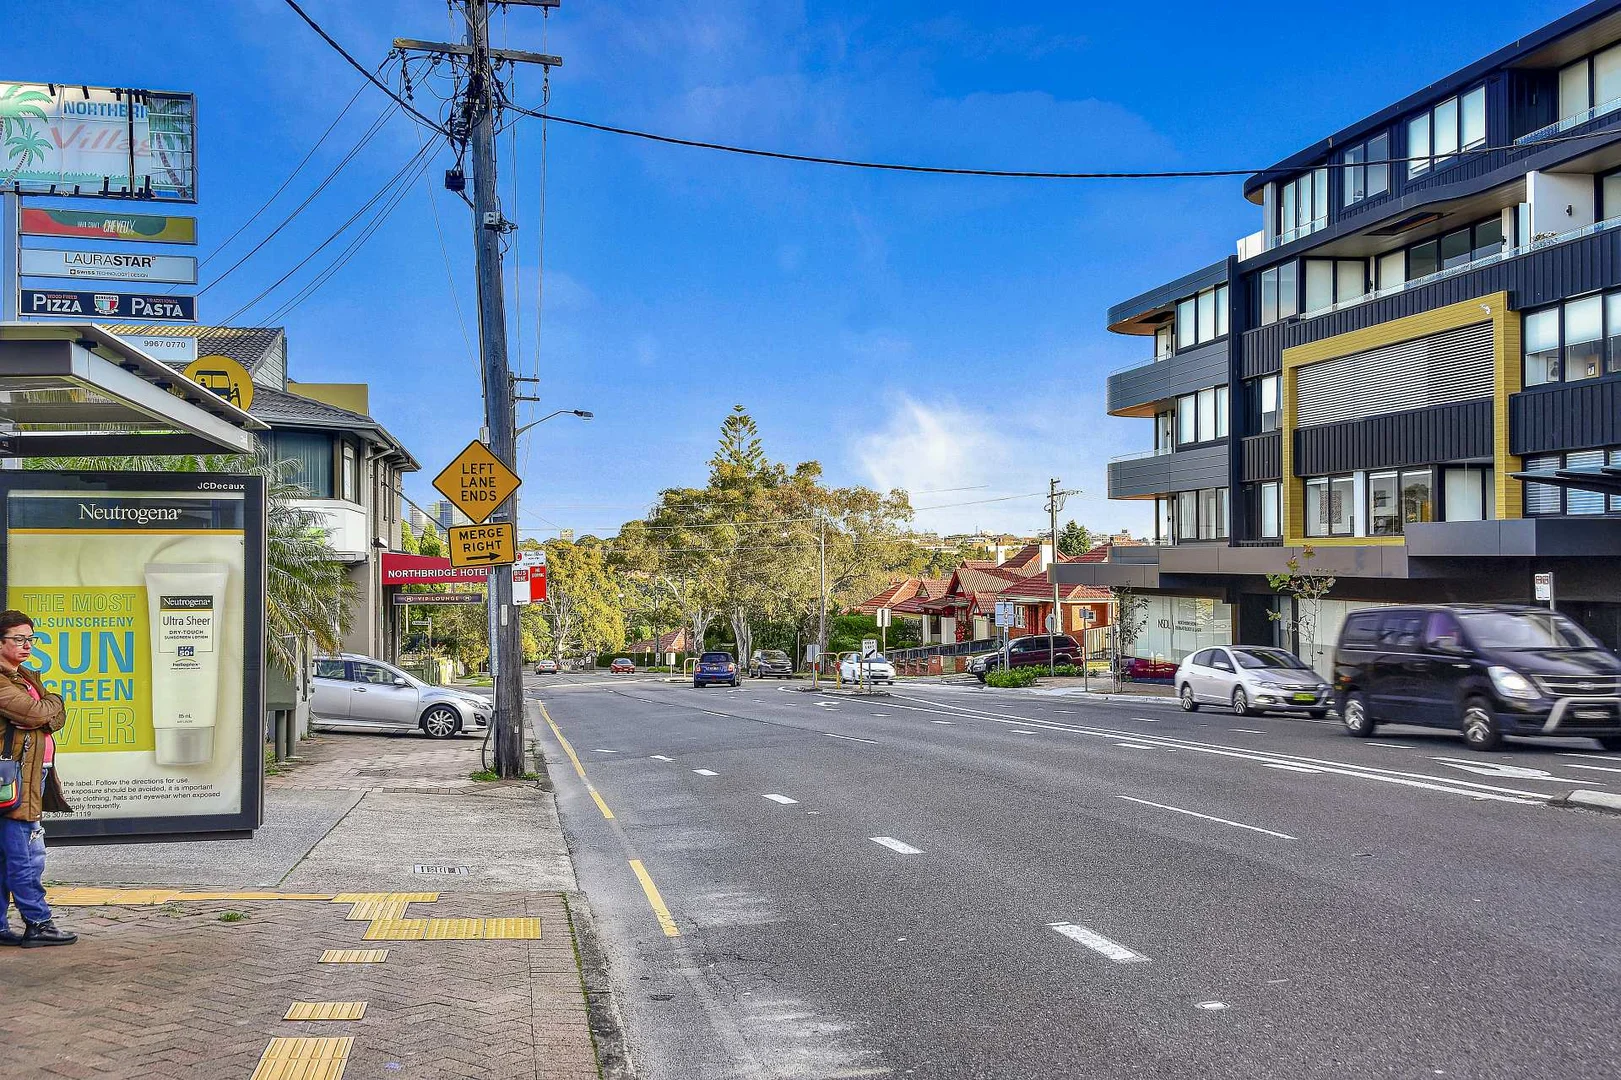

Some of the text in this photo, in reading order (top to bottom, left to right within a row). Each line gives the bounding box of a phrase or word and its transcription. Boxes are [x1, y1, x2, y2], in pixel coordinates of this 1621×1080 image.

[64, 253, 152, 267] LAURASTAR
[33, 293, 83, 313] PIZZA
[131, 297, 184, 317] PASTA
[462, 463, 494, 475] LEFT
[197, 482, 245, 490] JCDecaux
[461, 477, 497, 488] LANE
[461, 490, 497, 501] ENDS
[78, 503, 179, 524] Neutrogena
[459, 527, 504, 541] MERGE
[463, 540, 502, 553] RIGHT
[388, 568, 488, 578] NORTHBRIDGE HOTEL
[23, 594, 136, 612] THE MOST
[163, 598, 209, 607] Neutrogena
[32, 617, 134, 628] N-SUNSCREENY
[163, 616, 211, 626] Ultra Sheer
[23, 631, 135, 675] SUN
[56, 706, 136, 746] VER
[143, 792, 172, 801] eyewear
[192, 791, 221, 799] exposed
